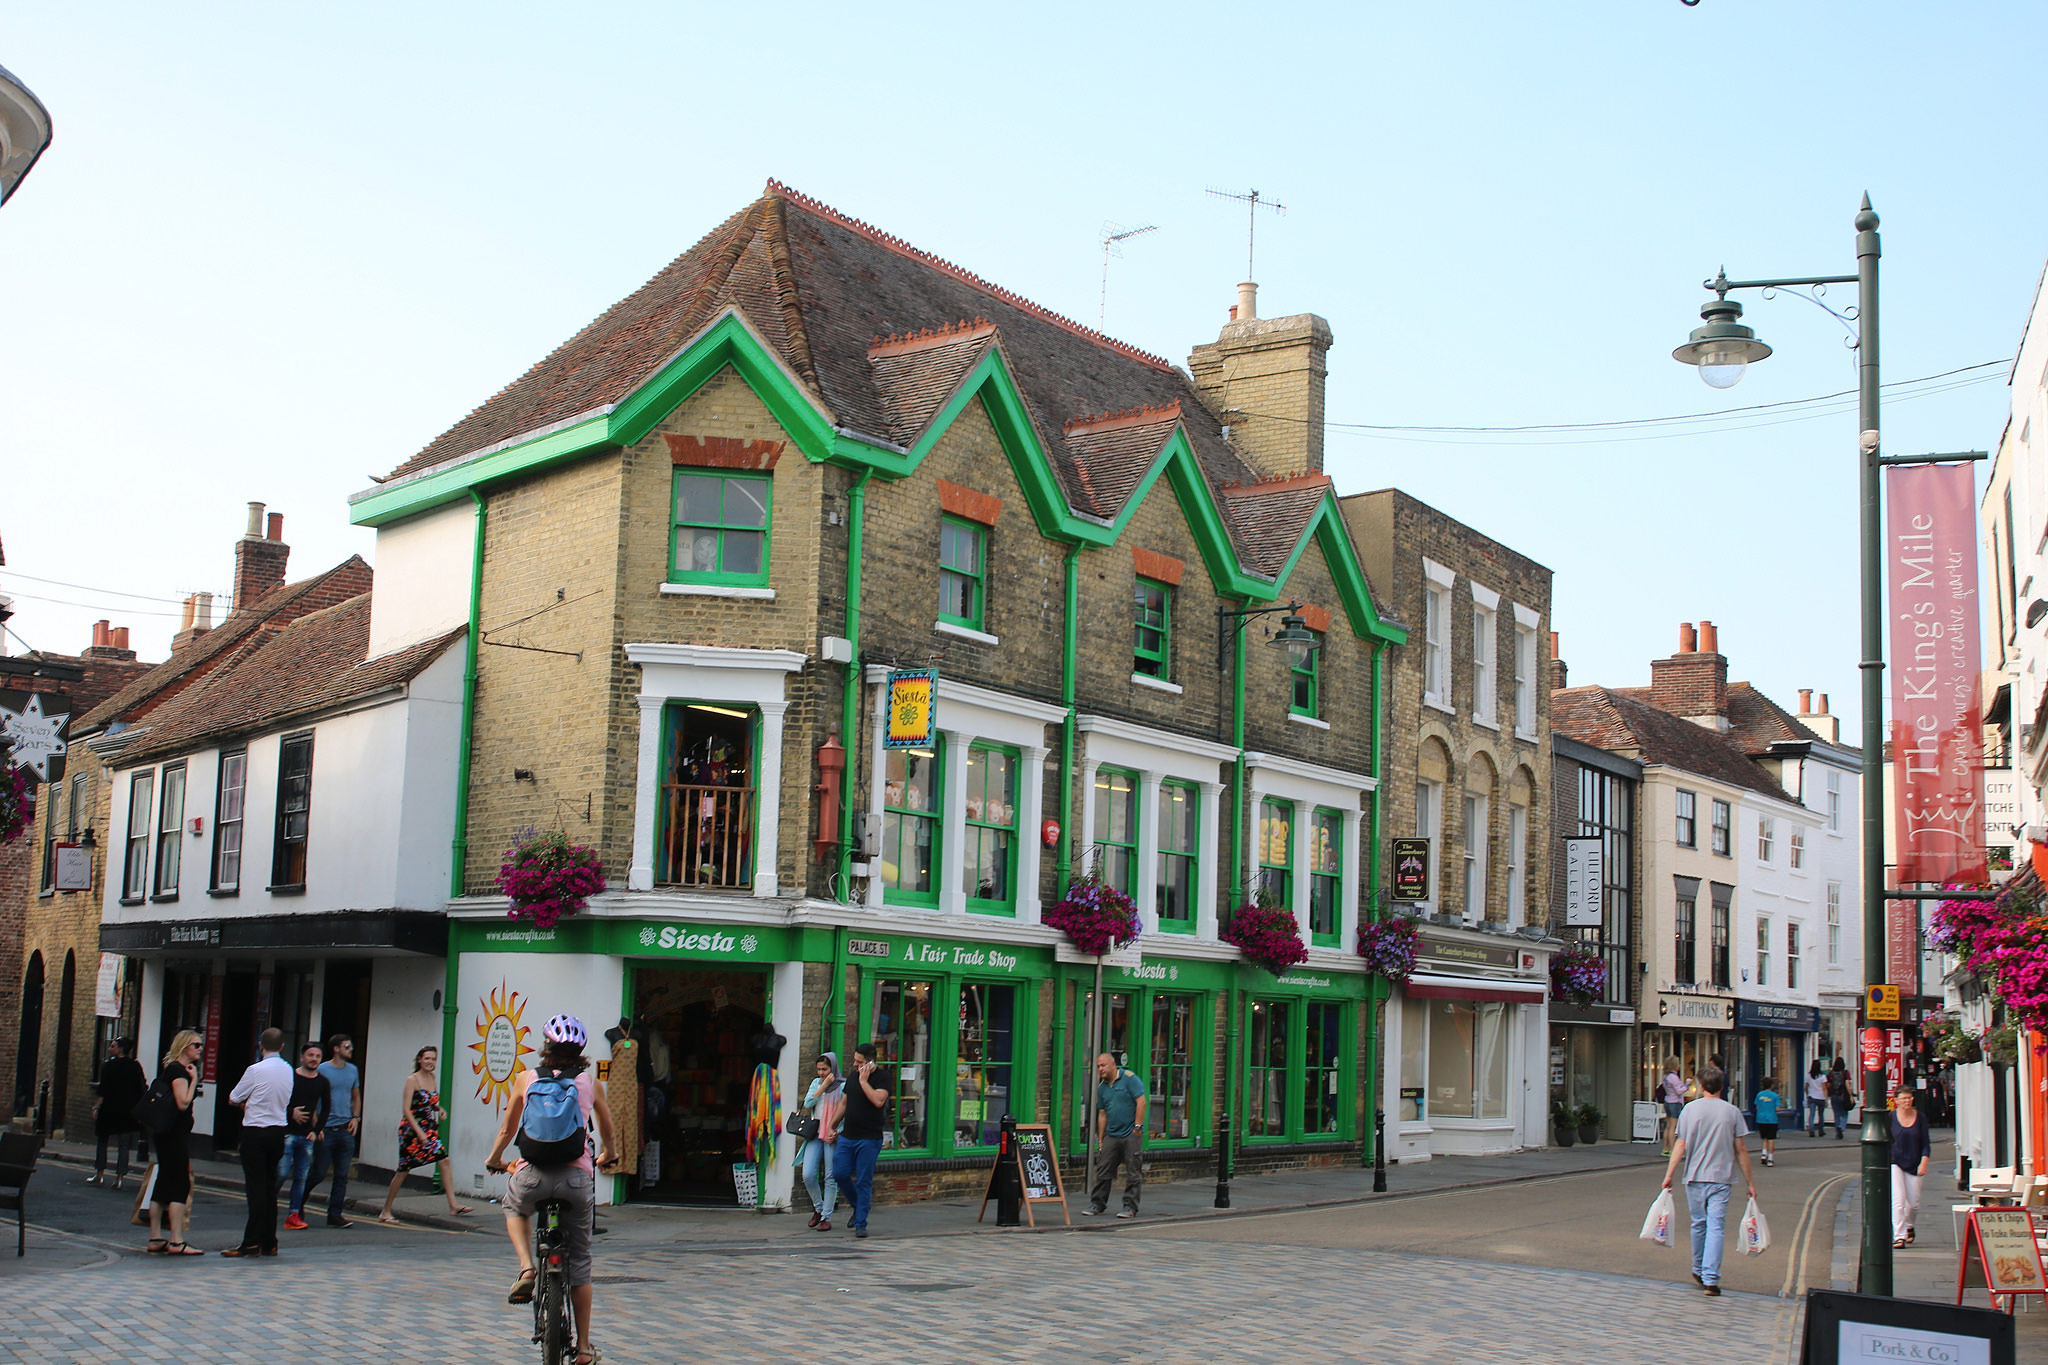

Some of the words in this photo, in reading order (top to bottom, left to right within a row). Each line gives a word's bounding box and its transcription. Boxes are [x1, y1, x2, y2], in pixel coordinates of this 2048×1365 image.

[1898, 514, 1935, 591] Mile
[1944, 548, 1975, 600] quarter
[1946, 604, 1966, 669] creative
[1900, 601, 1944, 702] King's
[894, 686, 928, 706] Siesta
[11, 720, 51, 737] Seven
[1903, 714, 1939, 784] The
[1986, 783, 2013, 793] CITY
[1397, 849, 1426, 857] Canterbury
[1569, 843, 1579, 921] GALLERY
[1587, 851, 1600, 913] LILFORD
[486, 928, 556, 944] www.siestacrafts.co.uk
[1890, 910, 1905, 942] King's
[657, 926, 737, 953] Siesta
[850, 940, 878, 954] PALACE
[904, 943, 915, 961] A
[920, 944, 948, 963] Fair
[953, 946, 985, 966] Trade
[988, 950, 1017, 973] Shop
[1891, 946, 1903, 965] The
[1133, 962, 1167, 980] Siesta
[1677, 998, 1720, 1019] LIGHTHOUSE
[1028, 1171, 1052, 1185] HIRE
[1980, 1213, 1996, 1223] Fish
[2004, 1213, 2025, 1225] Chips
[1981, 1229, 1990, 1238] To
[1991, 1229, 2008, 1238] Take
[2009, 1229, 2033, 1240] Away
[1871, 1339, 1906, 1357] Pork
[1910, 1344, 1923, 1359] &
